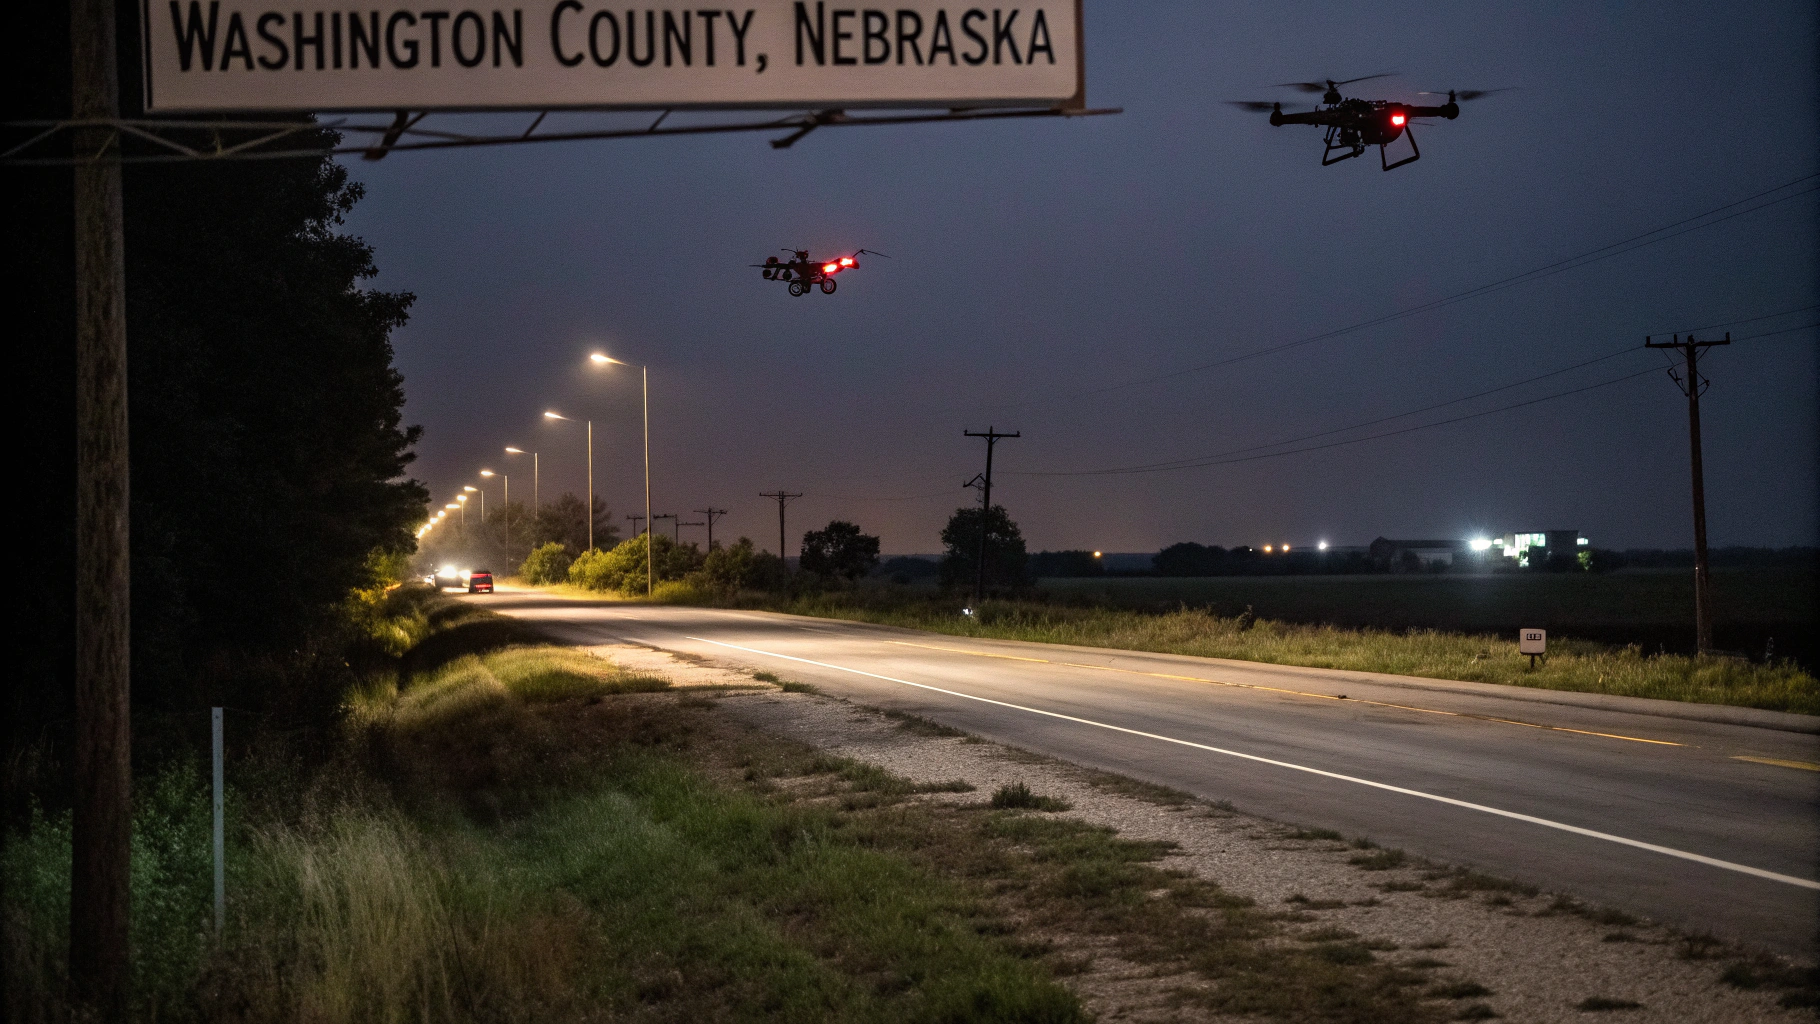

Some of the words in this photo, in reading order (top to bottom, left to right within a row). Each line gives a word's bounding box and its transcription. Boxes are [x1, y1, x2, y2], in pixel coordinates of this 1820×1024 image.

[170, 0, 525, 72] WASHINGTON
[550, 0, 769, 74] COUNTY,
[794, 0, 1056, 67] NEBRASKA
